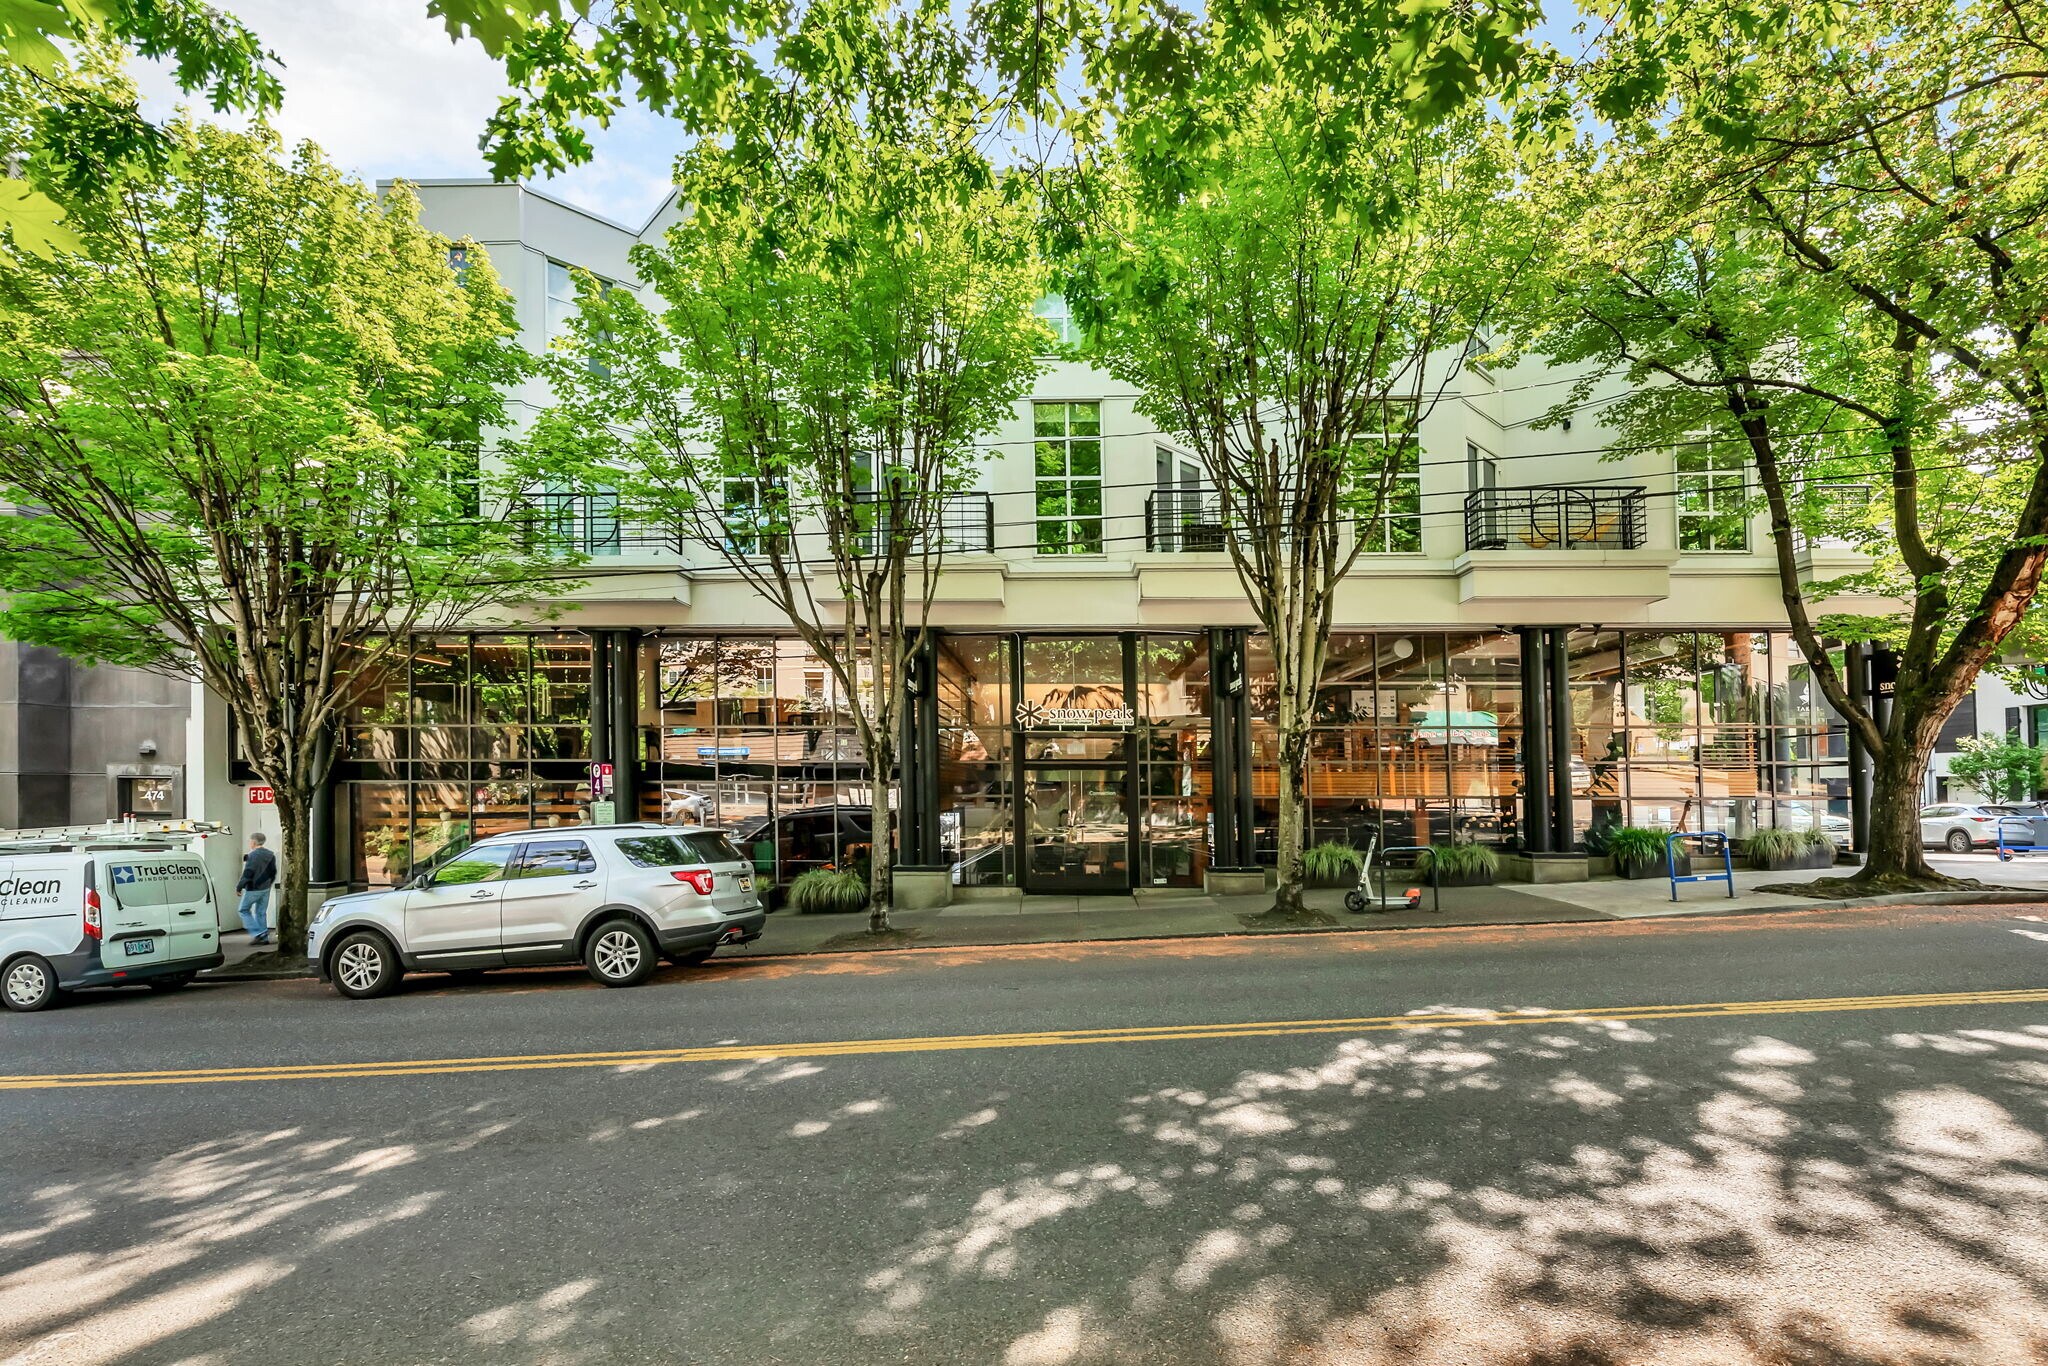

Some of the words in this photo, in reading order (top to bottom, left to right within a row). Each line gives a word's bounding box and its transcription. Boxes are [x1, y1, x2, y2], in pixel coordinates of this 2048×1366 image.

[1879, 682, 1896, 690] sno
[1049, 708, 1089, 720] snow
[1094, 702, 1134, 725] peak
[143, 790, 165, 801] 474
[249, 789, 273, 801] FDC
[134, 863, 201, 877] TrueClean
[0, 877, 61, 896] Clean
[0, 896, 59, 906] CLEANING
